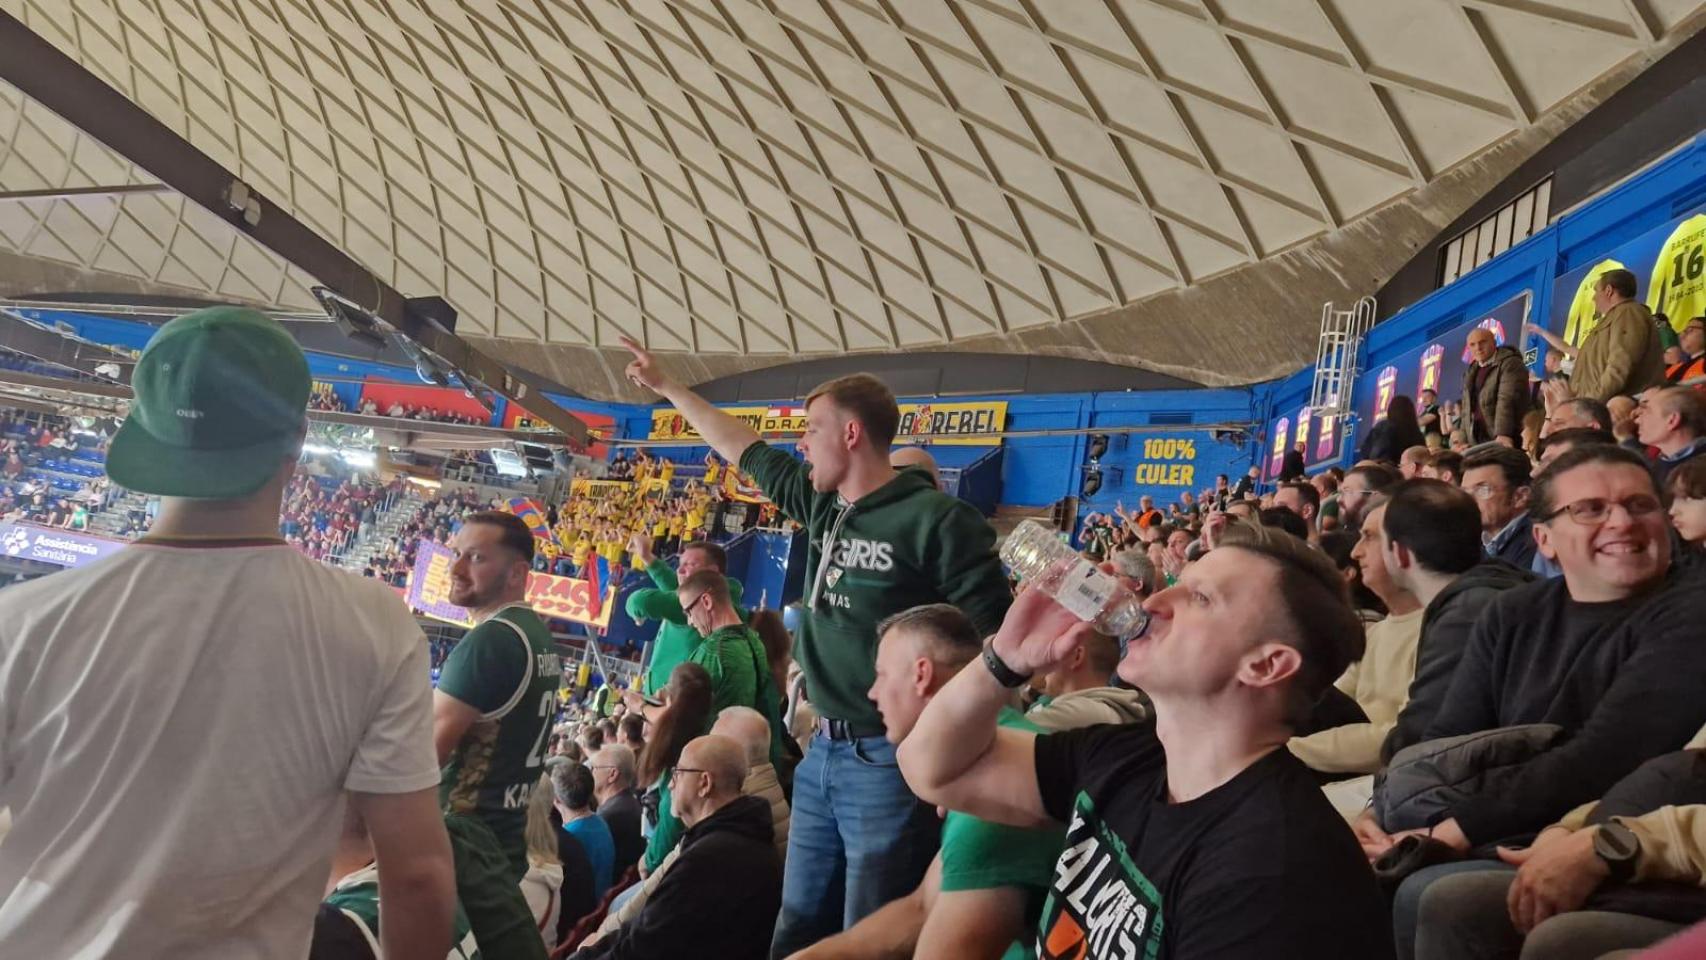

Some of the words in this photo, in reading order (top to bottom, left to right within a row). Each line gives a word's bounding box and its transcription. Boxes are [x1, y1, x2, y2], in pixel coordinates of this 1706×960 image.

[1671, 244, 1705, 288] 16
[1143, 438, 1196, 460] 100%
[1135, 463, 1195, 486] CULER
